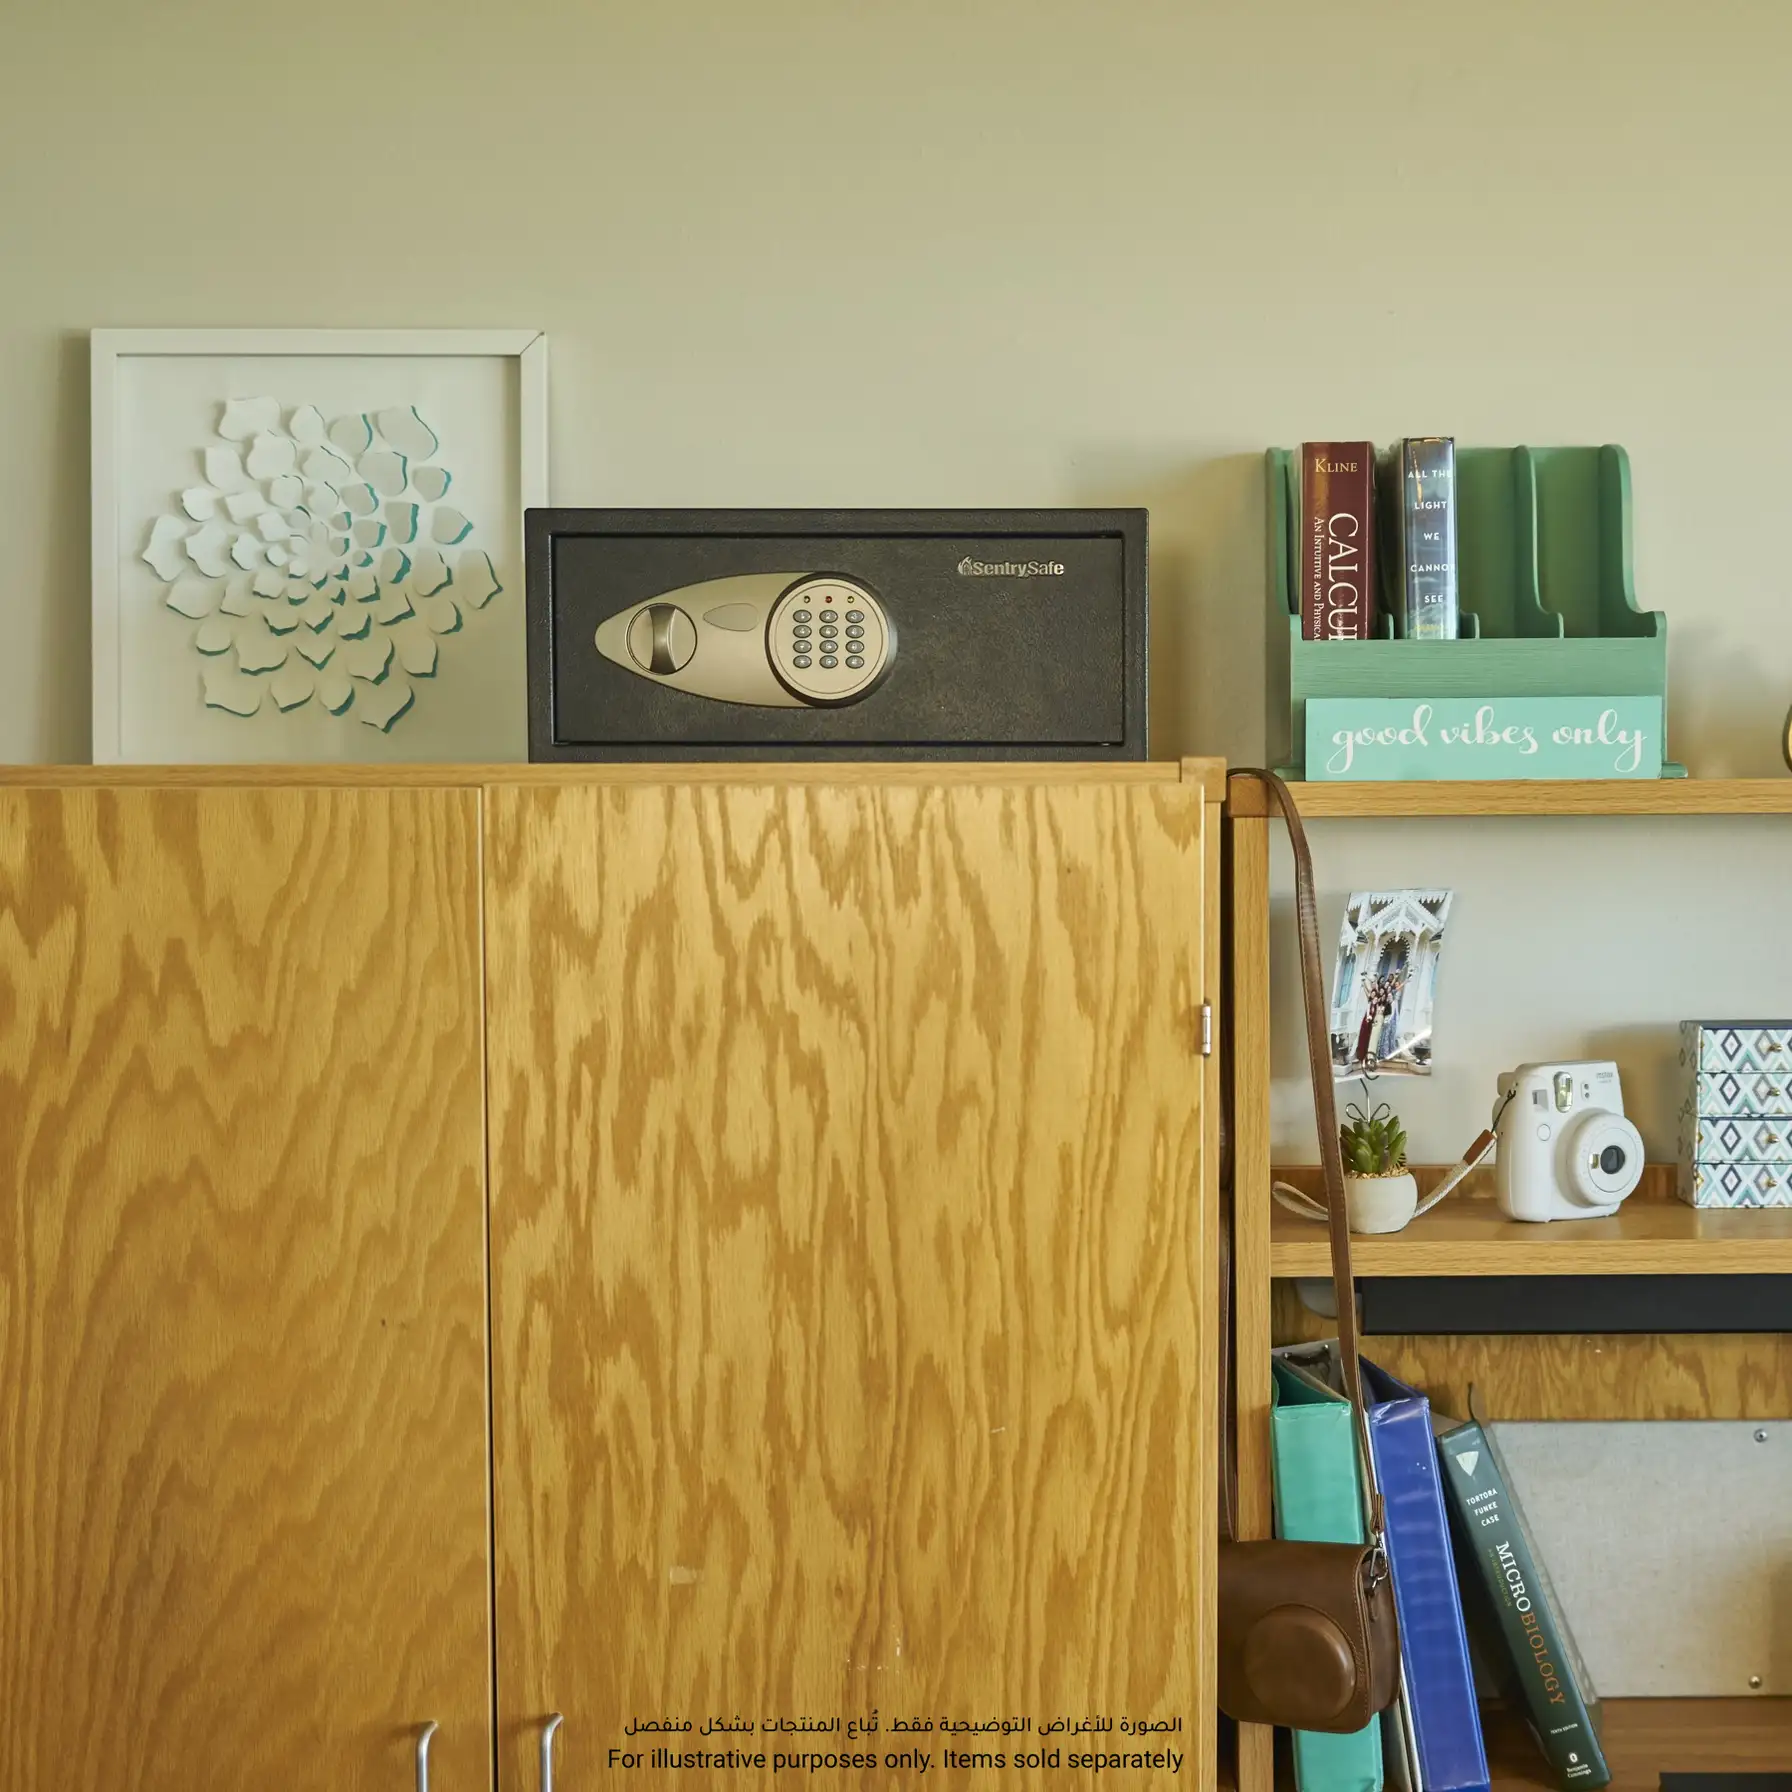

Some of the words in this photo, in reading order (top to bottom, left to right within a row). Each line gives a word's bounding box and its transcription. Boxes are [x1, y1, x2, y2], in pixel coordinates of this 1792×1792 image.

[1314, 458, 1358, 473] KLINE
[1408, 469, 1428, 479] ALL
[1414, 501, 1447, 510] LIGHT
[1313, 516, 1325, 532] AN
[1423, 532, 1440, 541] WE
[1313, 534, 1325, 579] INTUITIVE
[971, 560, 1065, 578] SentrySafe
[1313, 581, 1322, 600] AND
[1424, 595, 1444, 603] SEE
[1313, 603, 1325, 640] PHYSICA
[1326, 704, 1433, 774] good
[1440, 705, 1539, 755] vibes
[1552, 708, 1648, 773] only
[1466, 1487, 1498, 1506] TORTORA
[1474, 1501, 1498, 1516] FUNKE
[1481, 1514, 1500, 1527] CASE
[1495, 1540, 1565, 1704] MICROBIOLOGY
